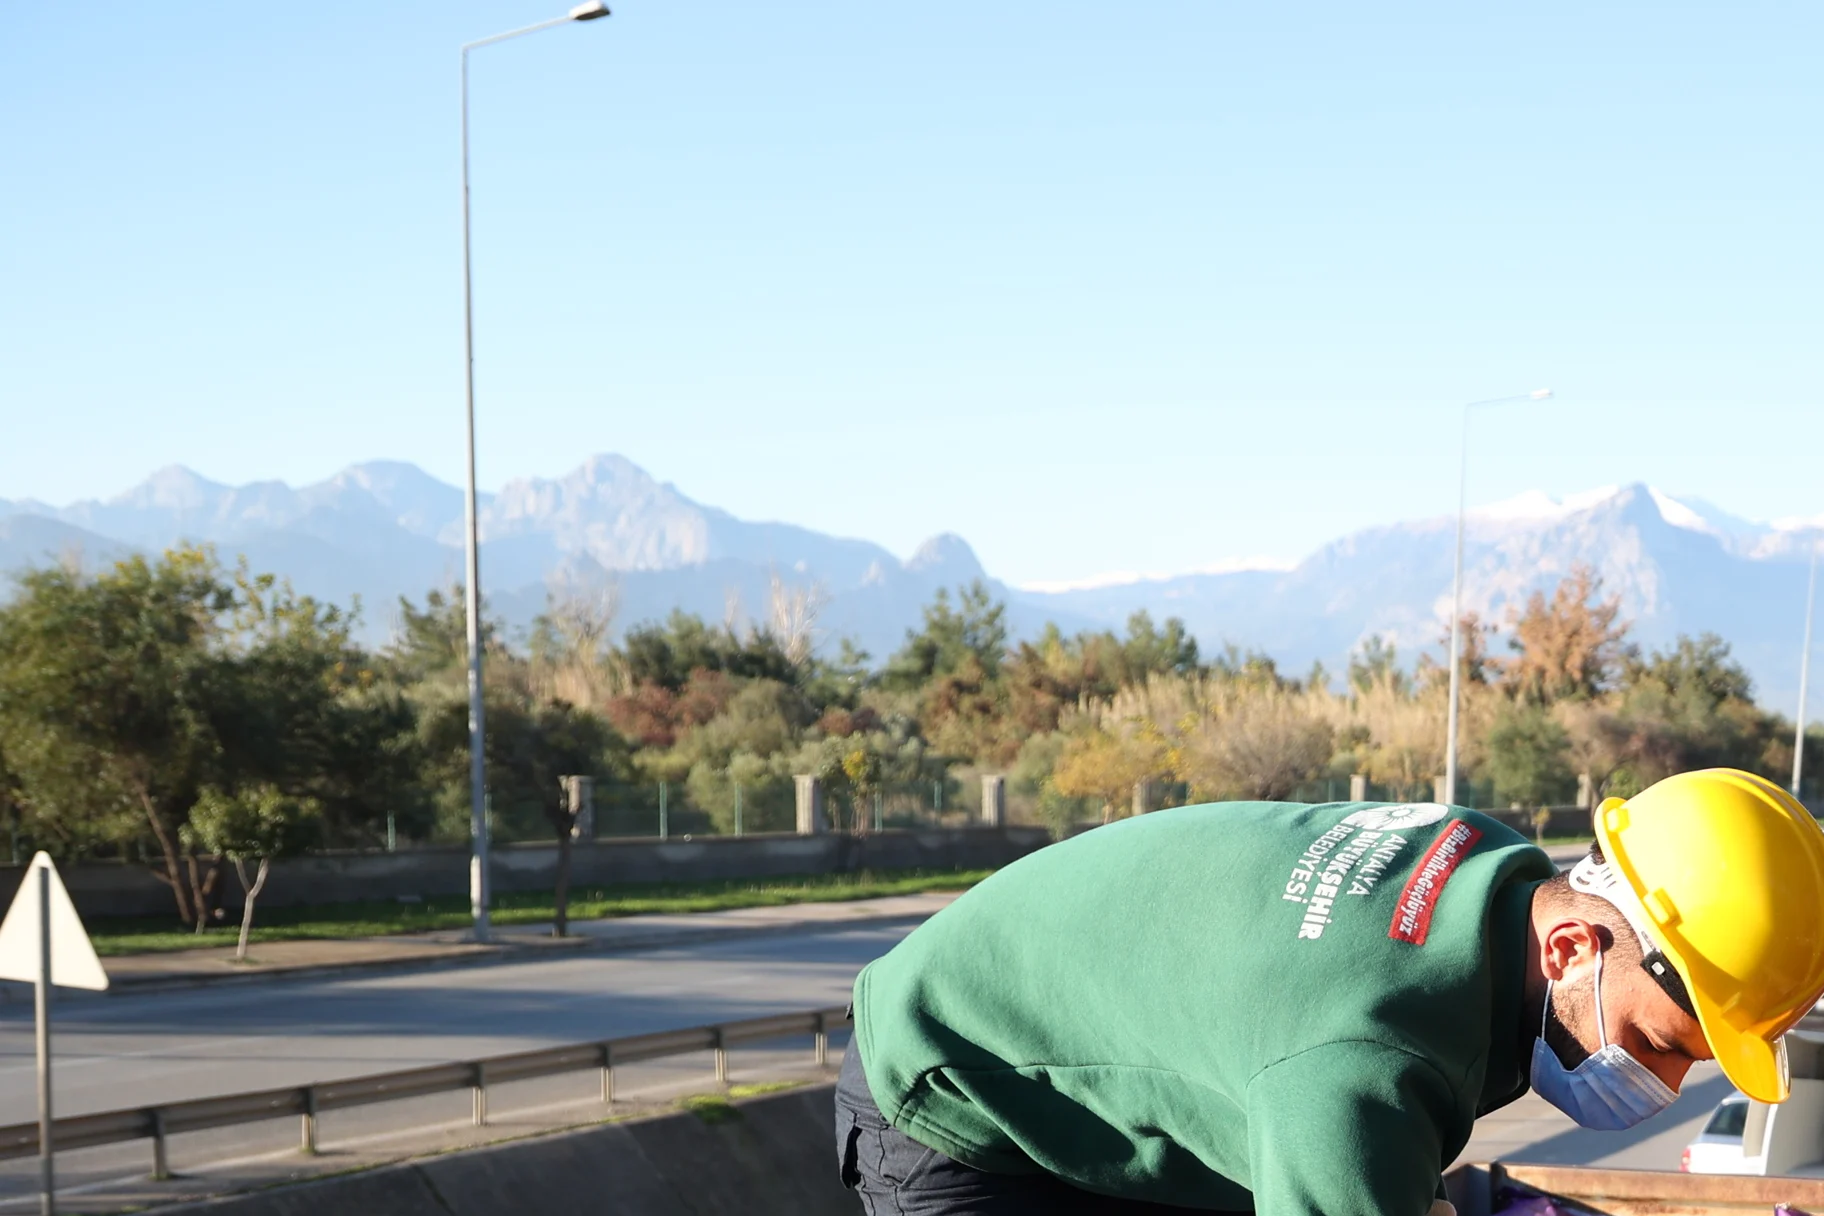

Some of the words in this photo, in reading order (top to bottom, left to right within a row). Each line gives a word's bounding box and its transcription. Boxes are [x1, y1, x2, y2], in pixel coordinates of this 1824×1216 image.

[1282, 822, 1355, 905] BELEDİYESİ
[1297, 830, 1384, 940] BÜYÜKŞEHİR
[1346, 833, 1408, 896] ANTALYA
